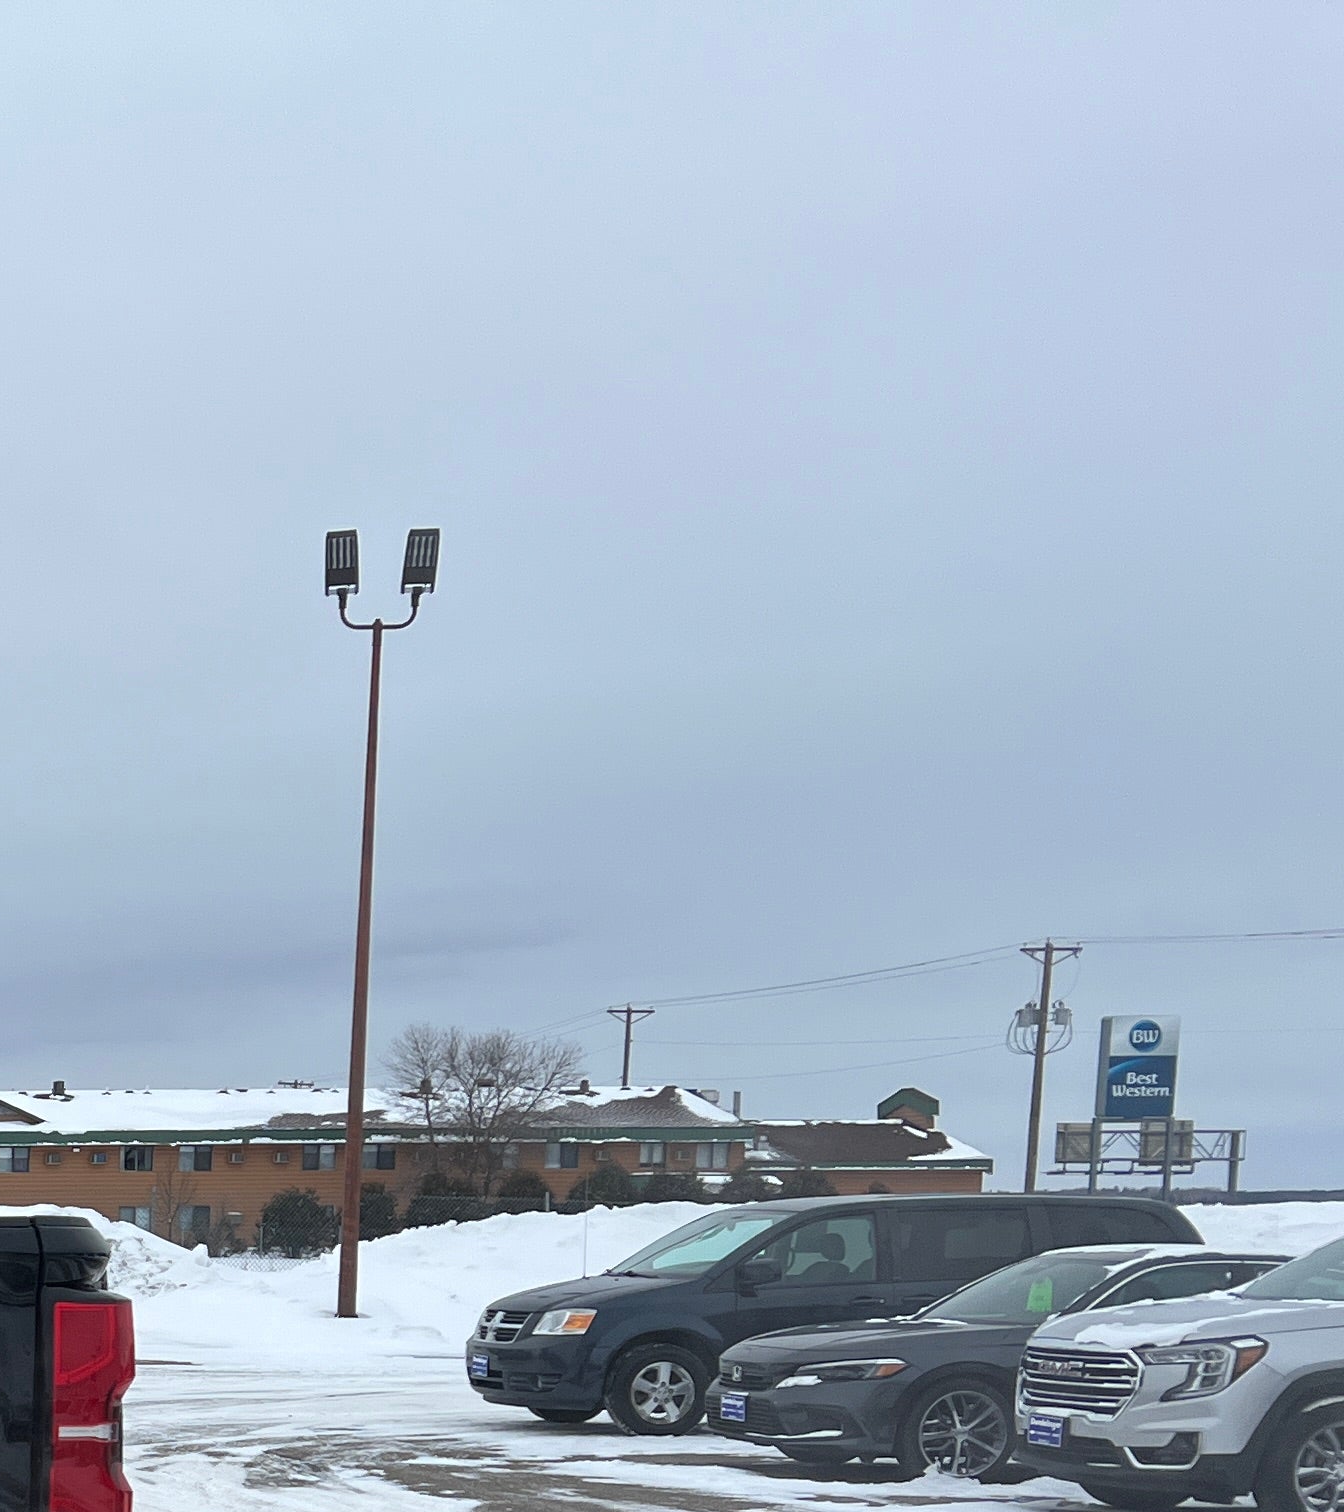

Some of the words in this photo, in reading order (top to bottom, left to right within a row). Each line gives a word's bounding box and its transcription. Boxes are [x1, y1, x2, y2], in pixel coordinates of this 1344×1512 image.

[1132, 1029, 1159, 1044] BW
[1126, 1072, 1159, 1085] Best
[1112, 1085, 1170, 1097] Western
[1038, 1360, 1084, 1377] GMC
